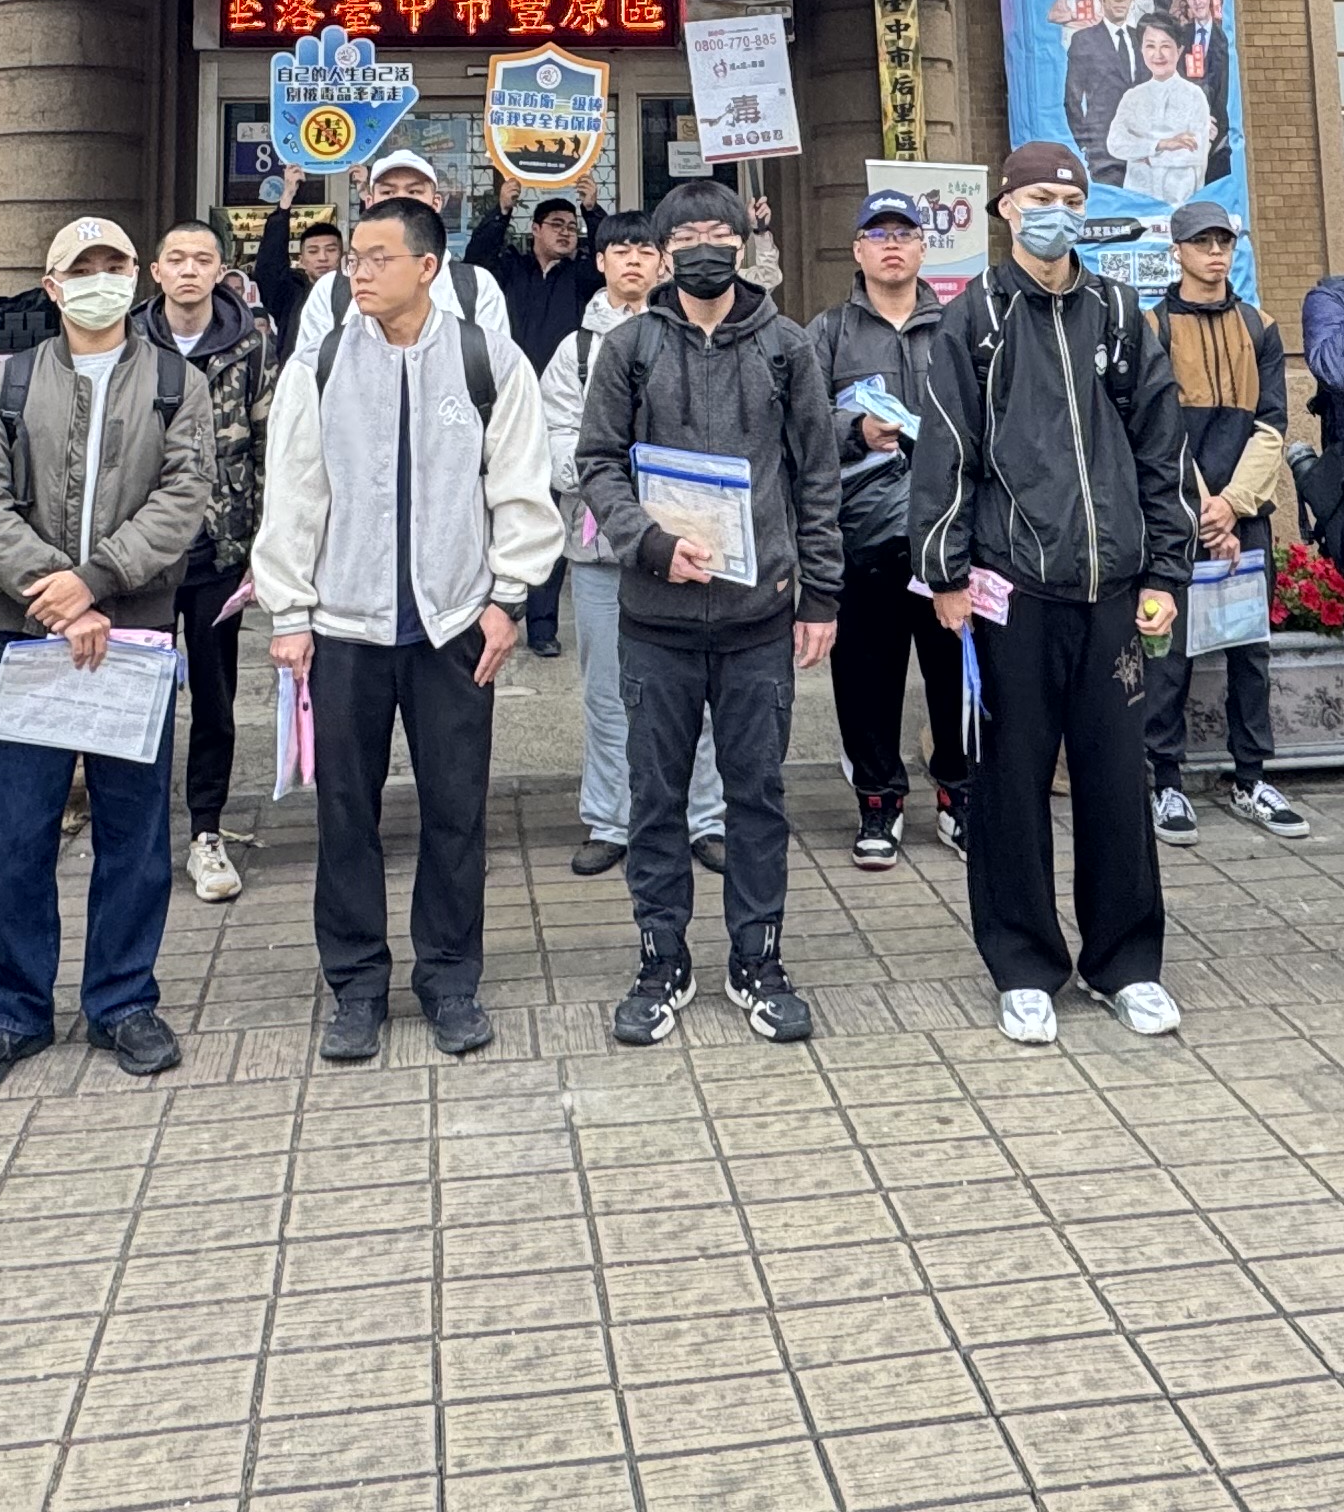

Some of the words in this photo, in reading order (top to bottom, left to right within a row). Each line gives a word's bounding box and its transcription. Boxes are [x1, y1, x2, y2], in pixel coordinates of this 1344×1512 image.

[694, 33, 777, 52] 0800-770-885
[278, 66, 410, 82] 自己的人生自己活
[77, 221, 102, 241] NY
